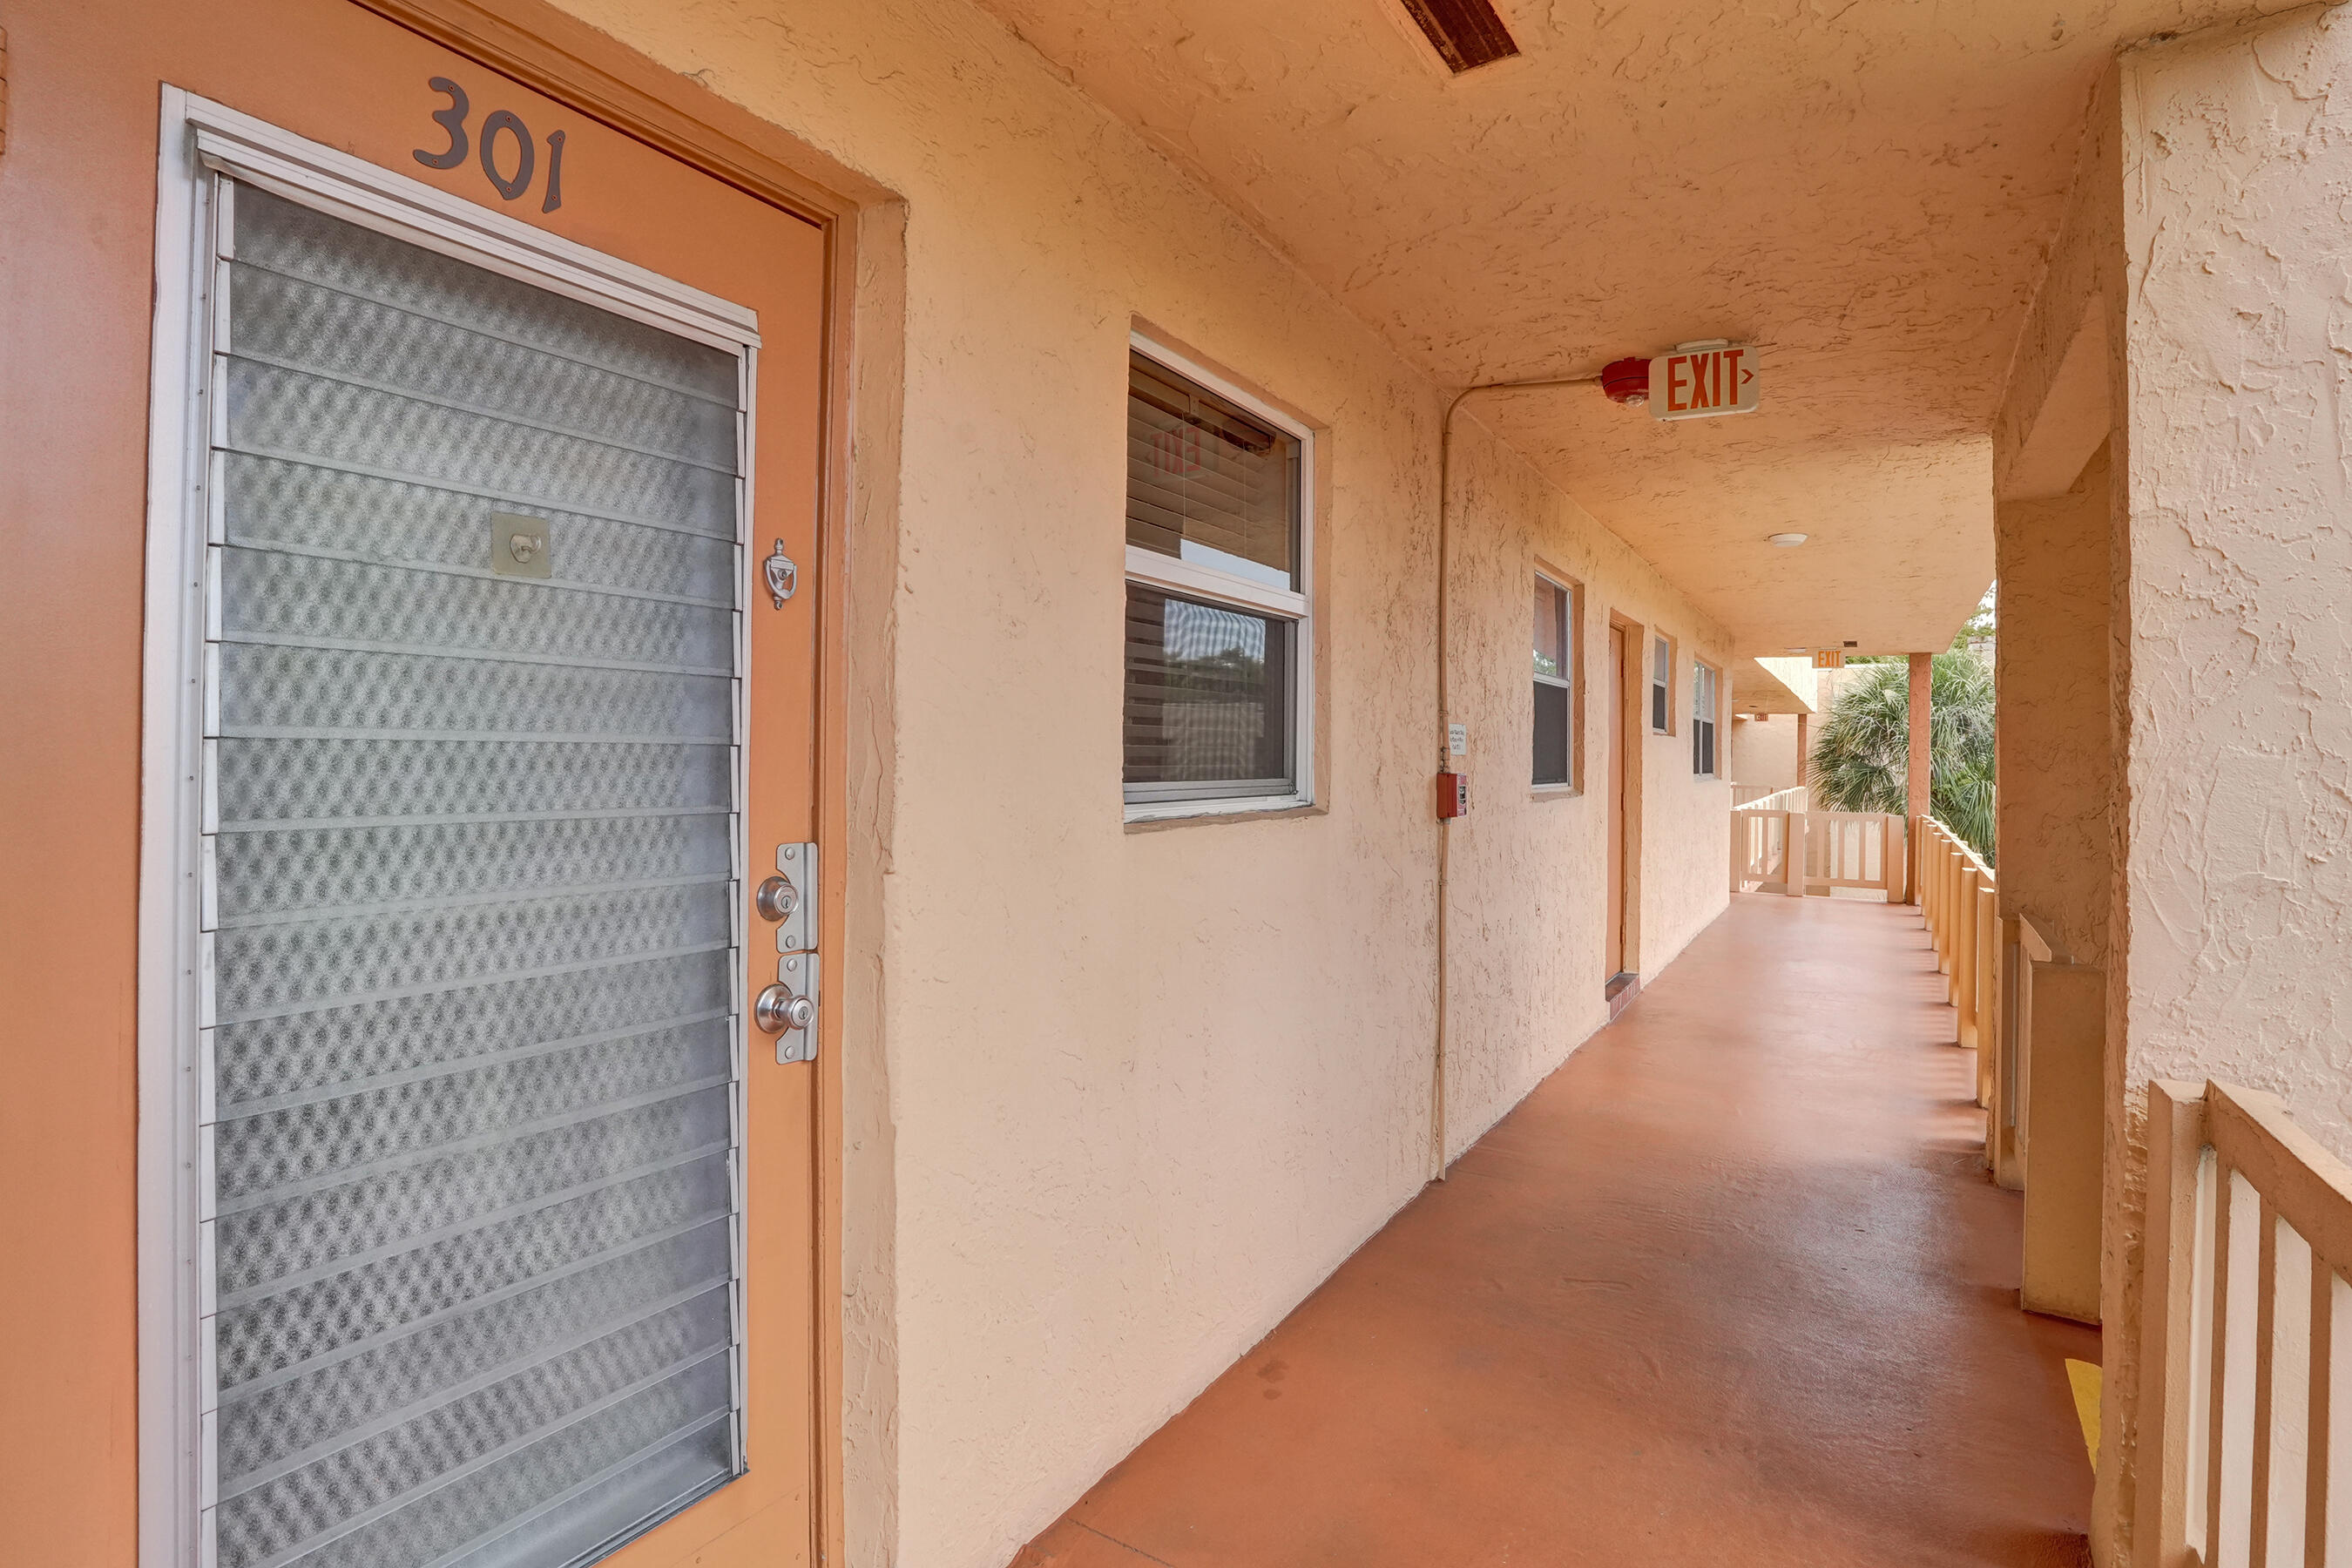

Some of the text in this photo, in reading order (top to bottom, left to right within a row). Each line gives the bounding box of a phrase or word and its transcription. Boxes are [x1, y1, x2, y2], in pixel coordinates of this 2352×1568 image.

[413, 76, 565, 213] 301
[1667, 349, 1744, 411] EXIT
[1818, 651, 1841, 667] EXIT
